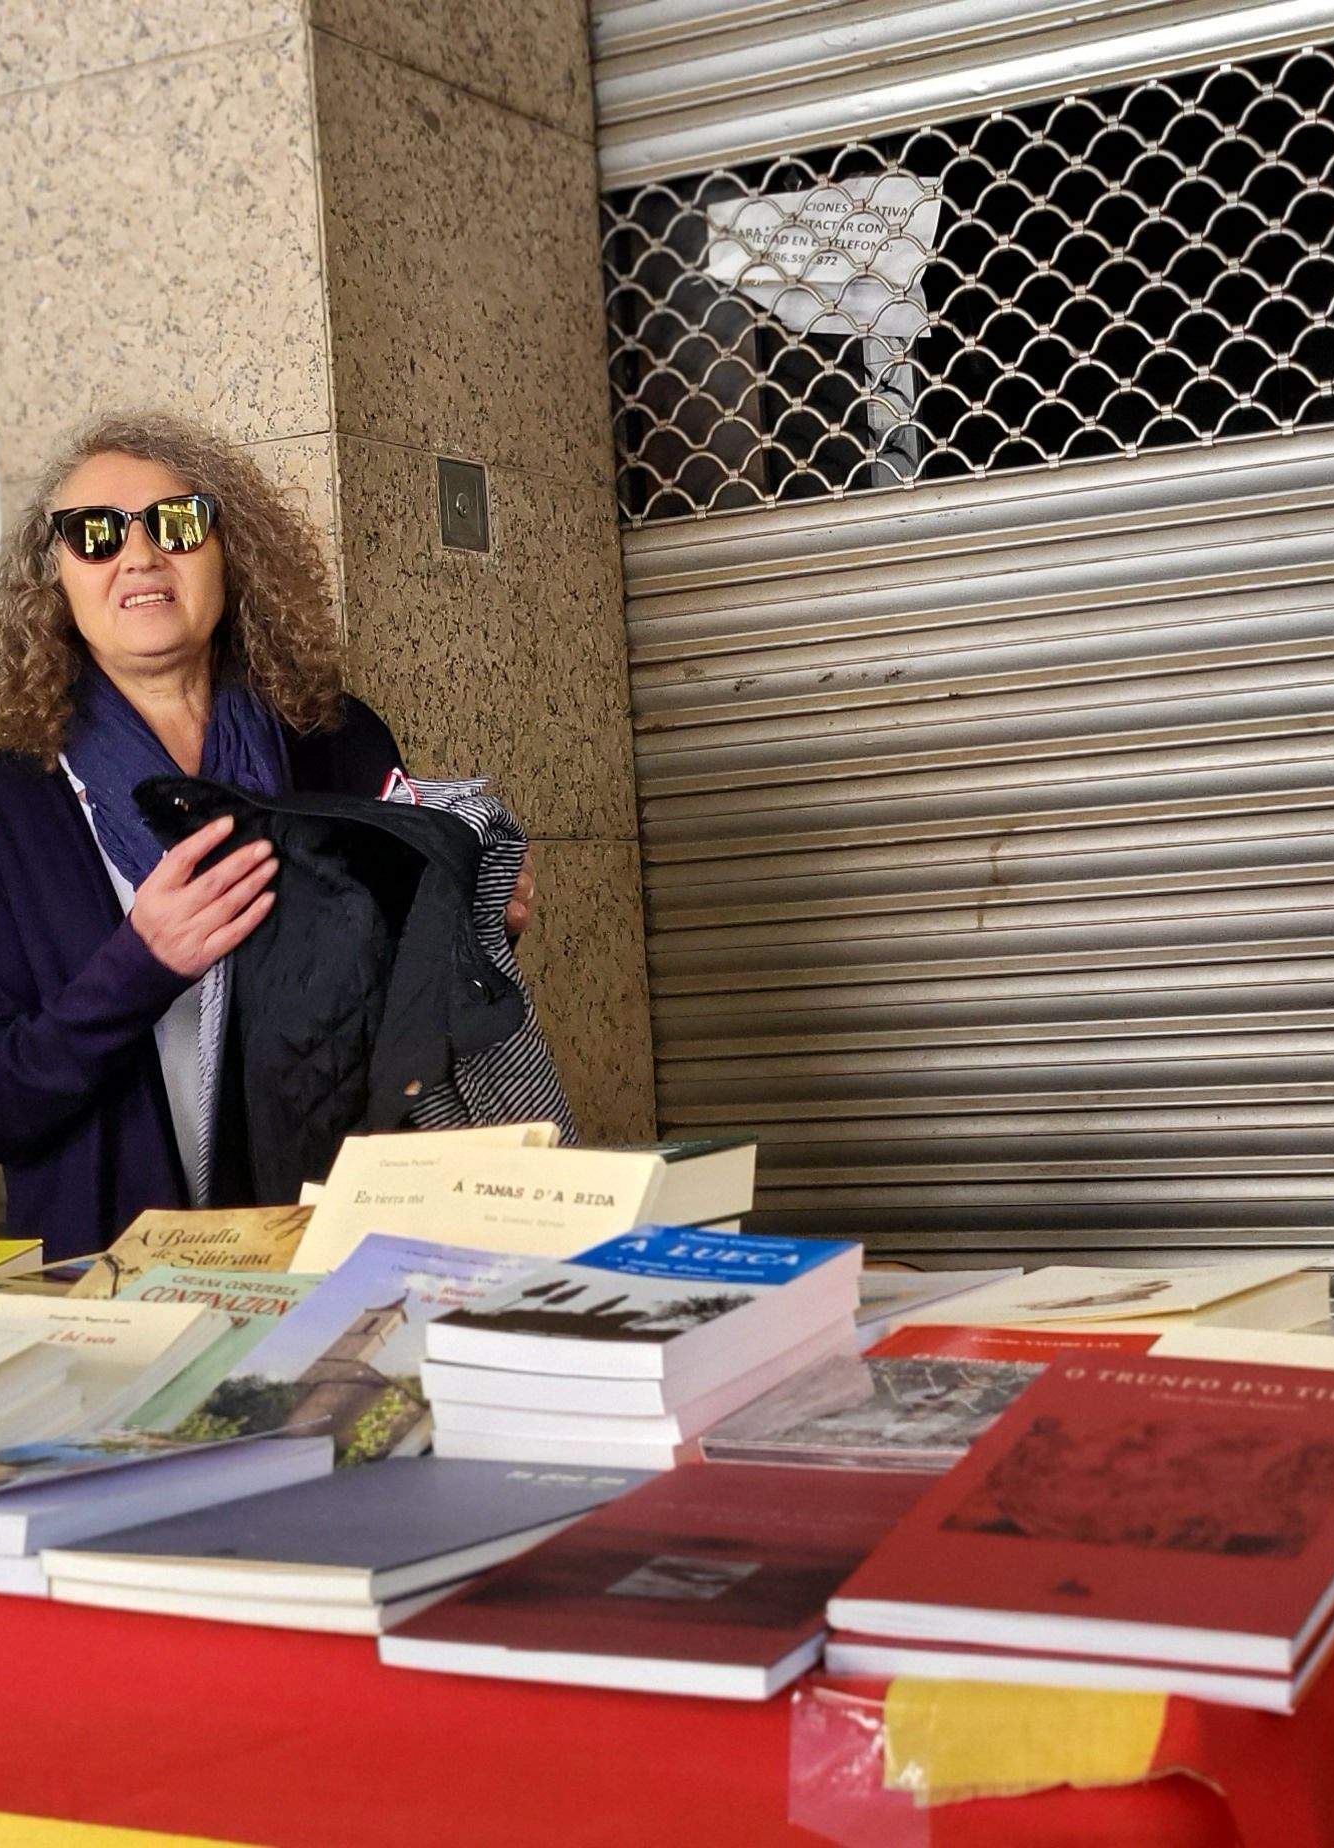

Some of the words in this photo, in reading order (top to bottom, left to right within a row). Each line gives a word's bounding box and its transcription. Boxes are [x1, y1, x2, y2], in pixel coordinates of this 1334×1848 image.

[857, 222, 885, 234] CON
[474, 1182, 526, 1199] TAMAS
[572, 1193, 616, 1207] BIDA
[158, 1227, 241, 1248] Batalla
[618, 1239, 649, 1253] A
[666, 1244, 801, 1266] LUECA
[1064, 1368, 1086, 1381] O
[1097, 1368, 1221, 1391] TRUNFO
[1230, 1380, 1285, 1396] D'O
